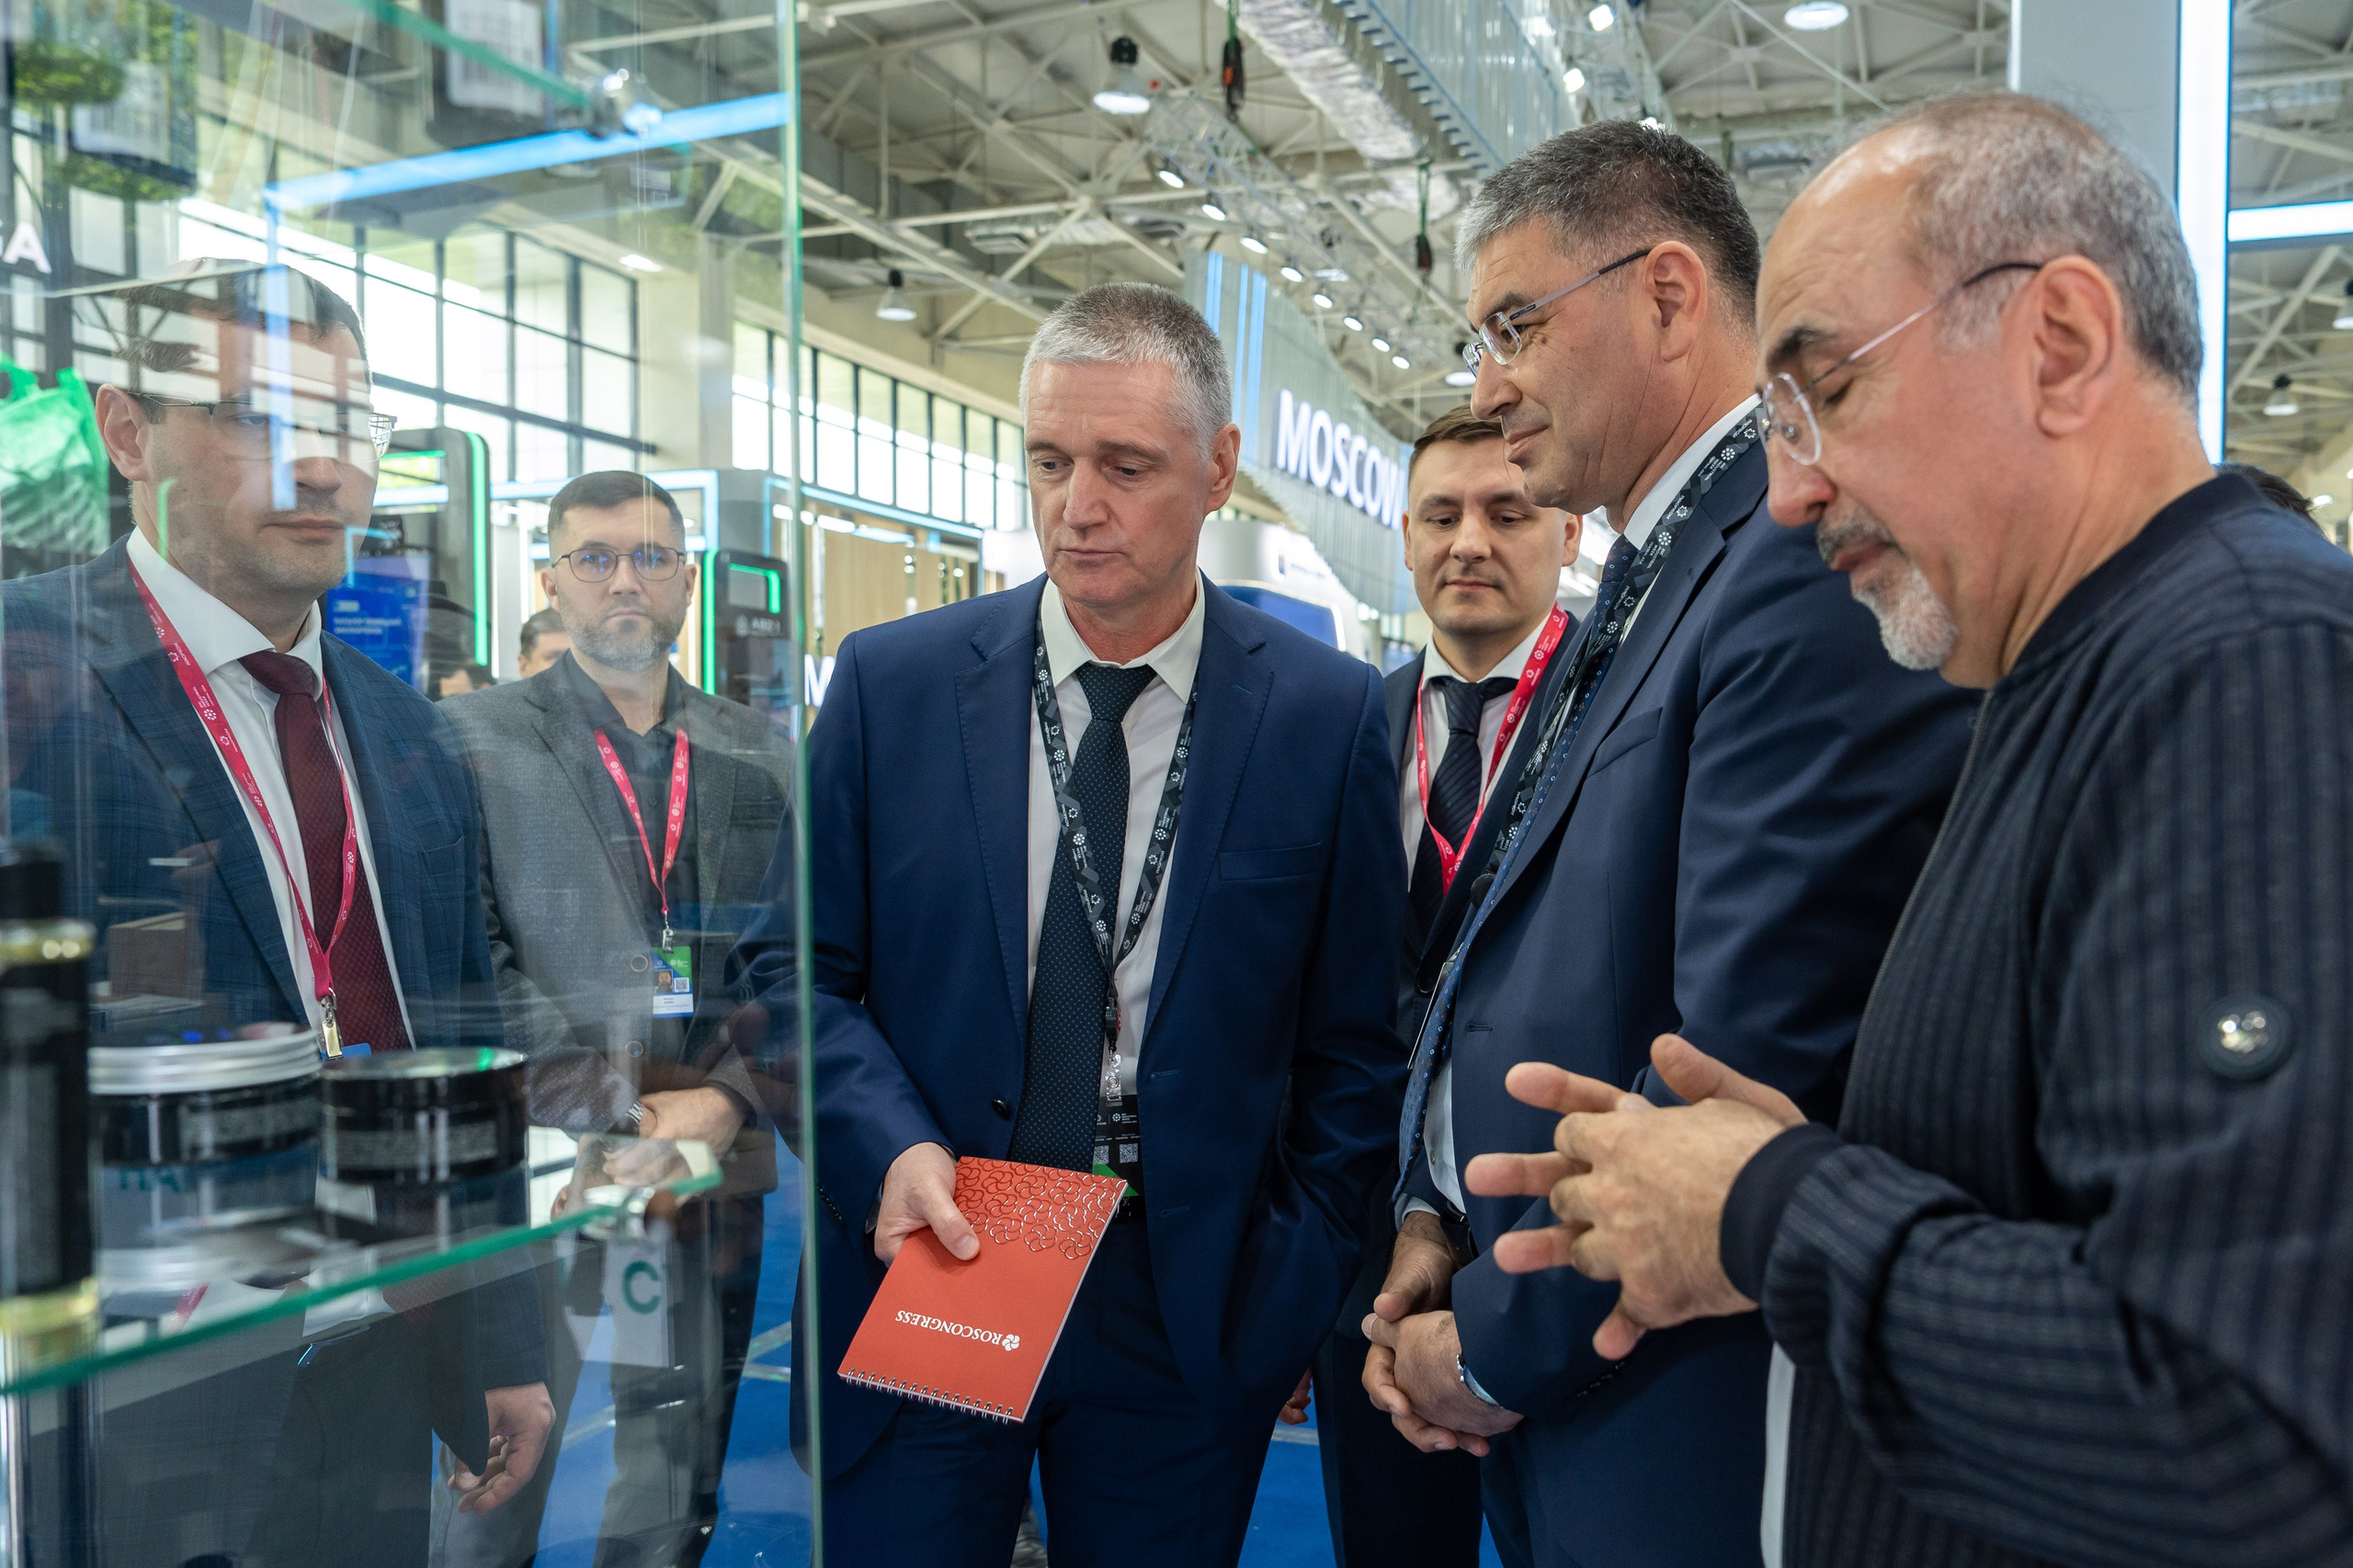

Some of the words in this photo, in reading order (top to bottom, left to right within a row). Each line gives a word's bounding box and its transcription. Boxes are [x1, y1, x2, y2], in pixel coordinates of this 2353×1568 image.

[1733, 419, 1753, 437] INNOPROM
[1277, 388, 1405, 530] MOSCOW
[1704, 460, 1722, 481] INDUSTRIAL
[1666, 494, 1685, 520] INNOPROM
[1647, 546, 1662, 569] INDUSTRIAL
[1614, 585, 1631, 610] INNOPROM
[174, 642, 191, 665] INNOPROM
[193, 687, 208, 708] INDUSTRIAL
[1178, 768, 1188, 790] INNOPROM
[1511, 791, 1520, 815] INNOPROM
[1062, 804, 1070, 827] INNOPROM
[1156, 851, 1165, 874] INNOPROM
[1083, 890, 1092, 913] INNOPROM
[895, 1310, 1004, 1346] ROSCONGRESS
